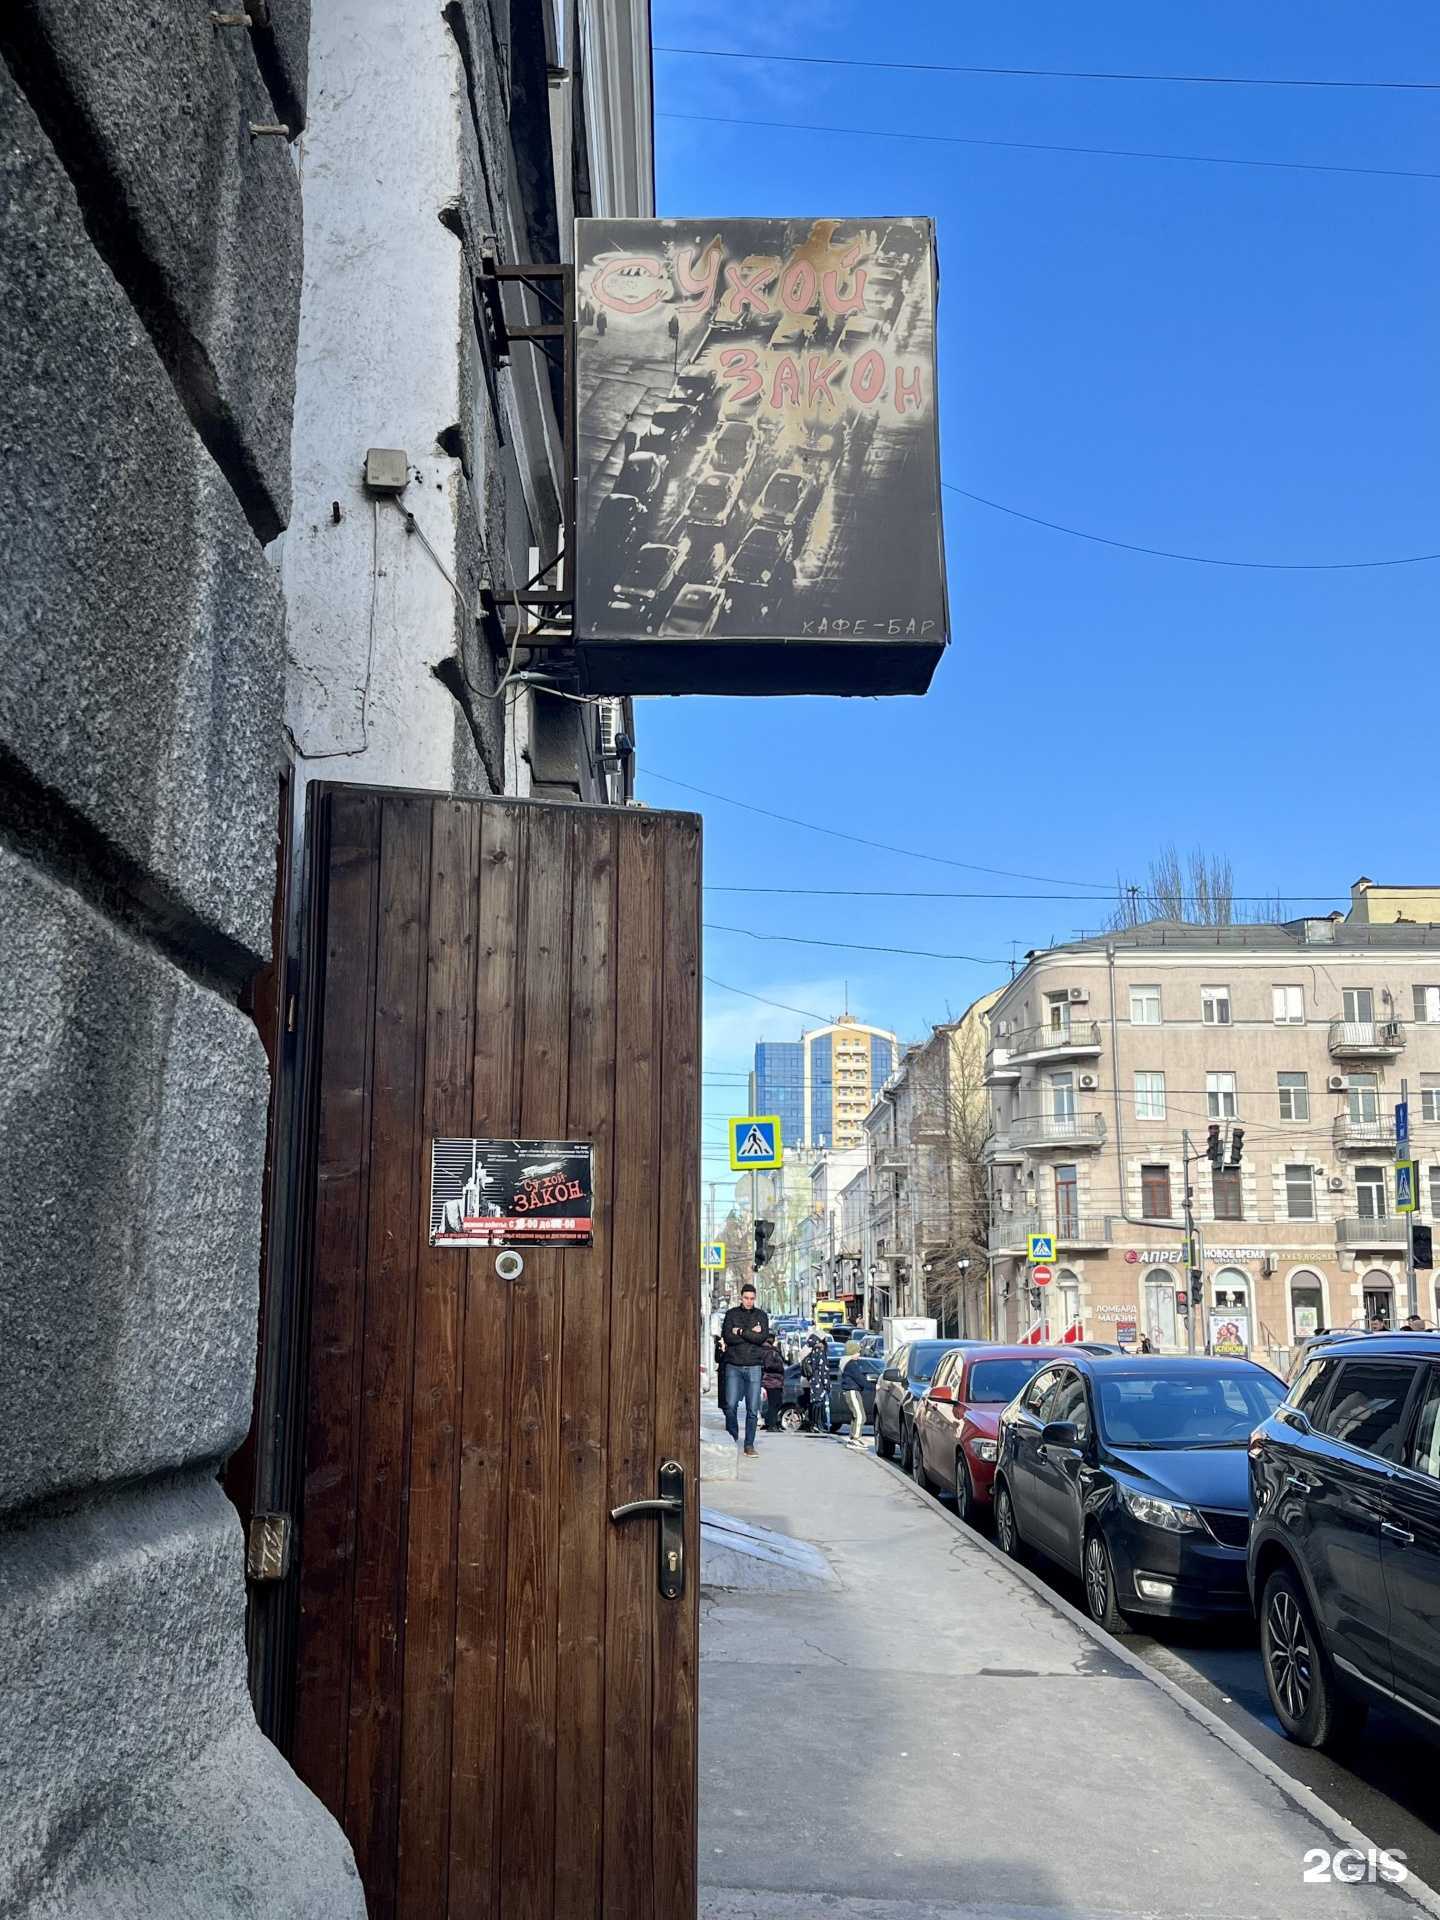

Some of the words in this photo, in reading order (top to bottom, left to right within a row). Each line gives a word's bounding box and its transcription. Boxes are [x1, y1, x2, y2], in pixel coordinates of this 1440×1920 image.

[590, 246, 868, 314] СУХОЙ
[720, 347, 925, 415] ЗАКОН
[801, 617, 936, 635] КАФЕ-БАР
[513, 1180, 584, 1212] ЗАКОН
[1139, 1250, 1183, 1263] АПРЕЛ
[1203, 1249, 1234, 1259] НОВОЕ
[1235, 1249, 1265, 1259] ВРЕМЯ
[1096, 1304, 1137, 1313] ЛОМБАРД
[1098, 1313, 1137, 1322] МАГАЗИН
